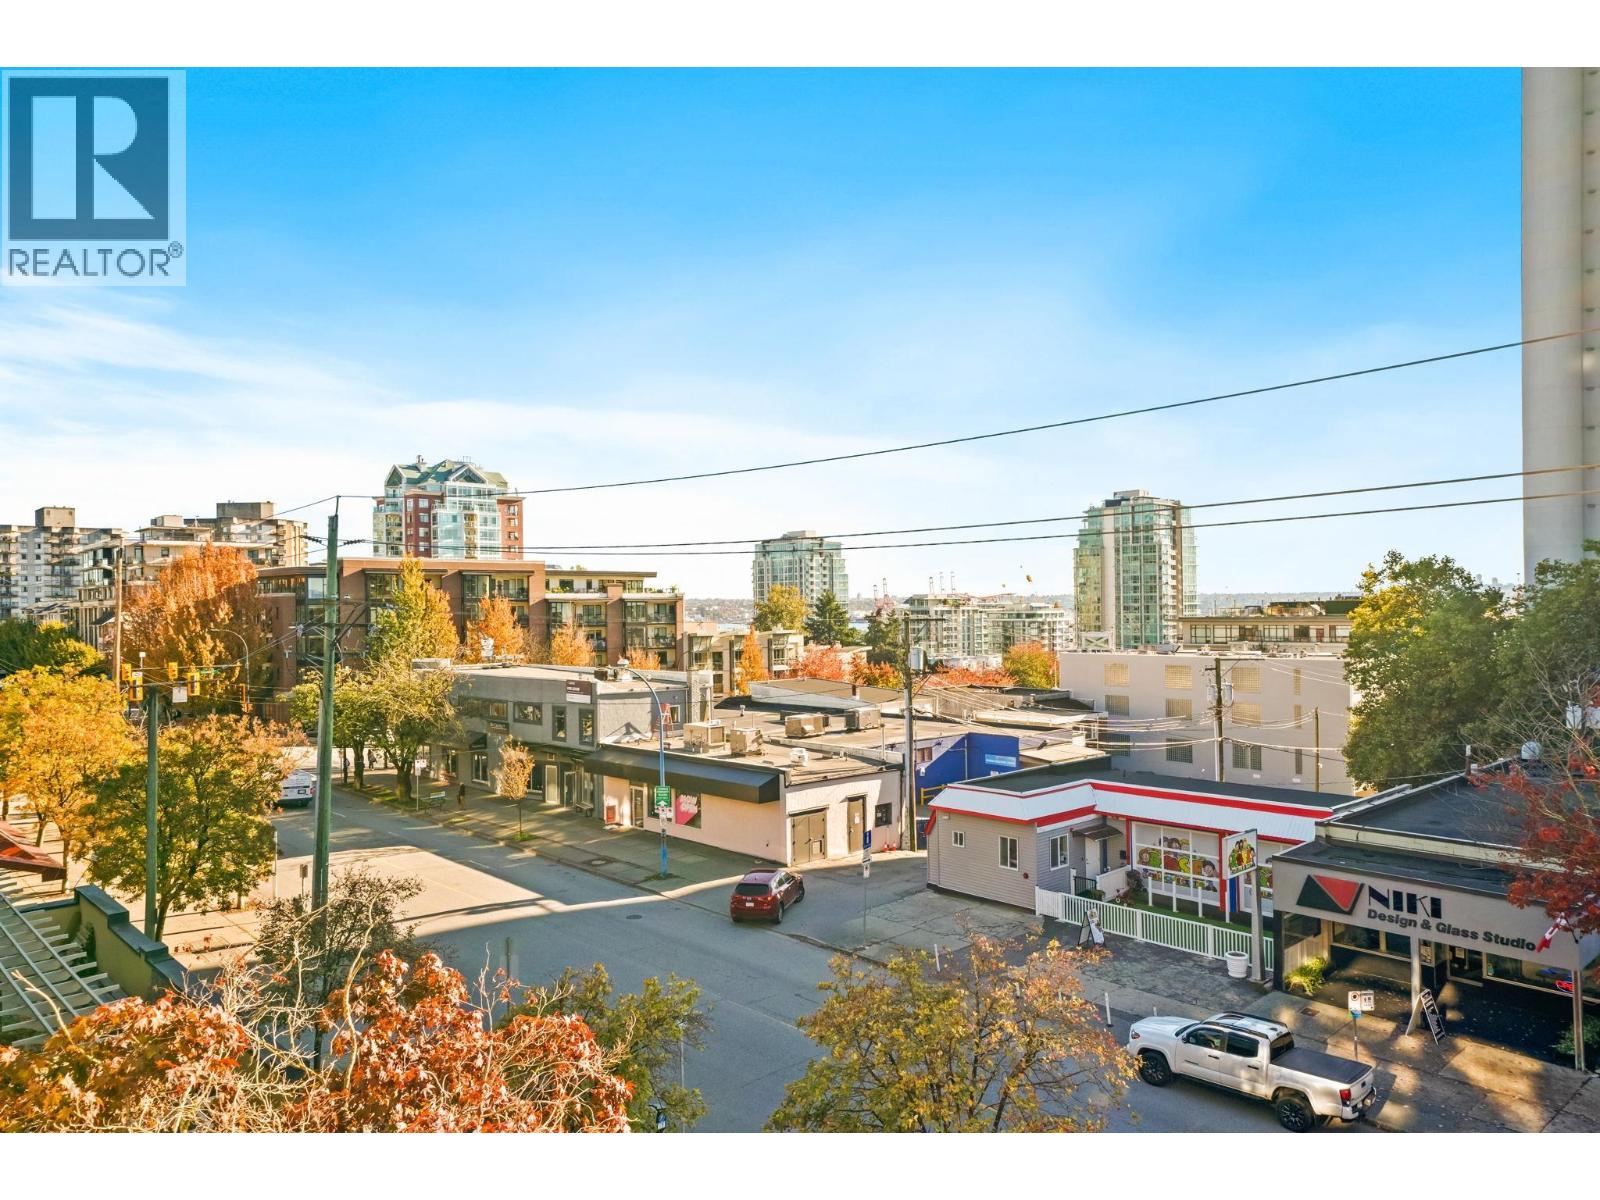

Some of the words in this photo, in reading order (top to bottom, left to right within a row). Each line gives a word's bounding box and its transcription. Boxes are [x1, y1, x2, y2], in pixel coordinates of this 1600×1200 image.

[1368, 885, 1442, 919] NIKI
[1367, 908, 1417, 929] Design
[1420, 919, 1432, 931] &
[1436, 922, 1479, 940] Glass
[1482, 931, 1536, 951] Studio
